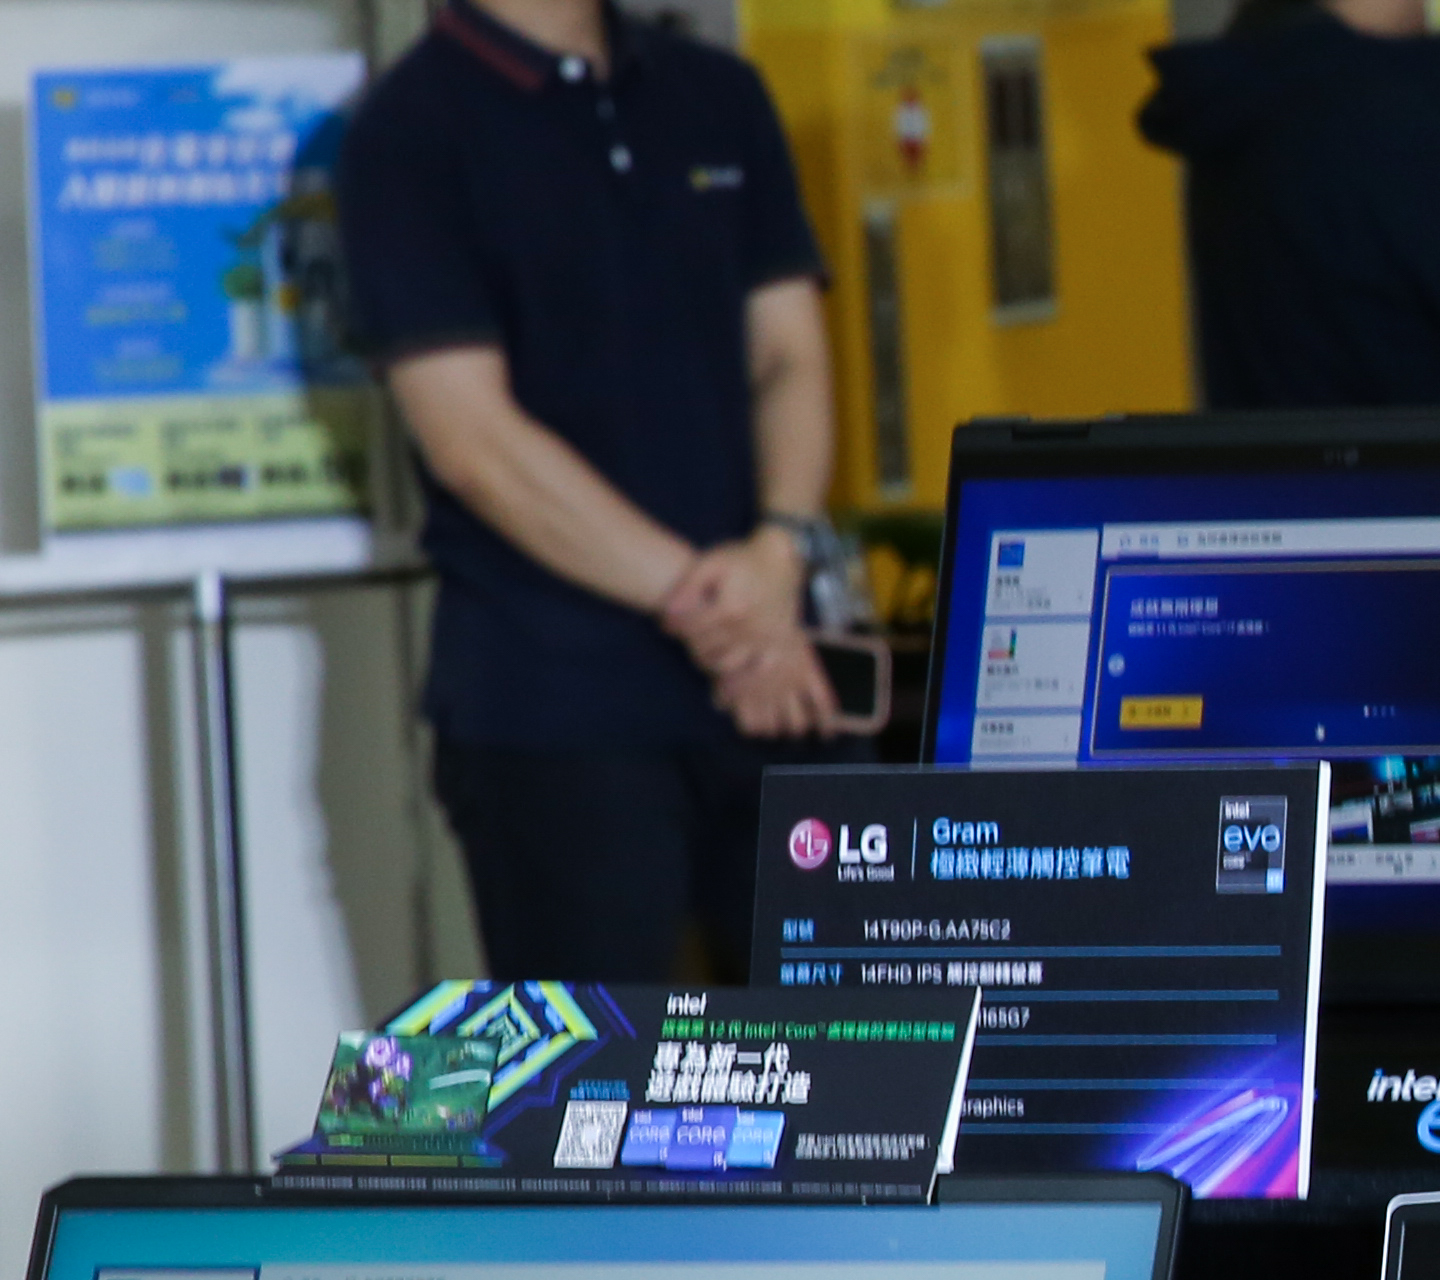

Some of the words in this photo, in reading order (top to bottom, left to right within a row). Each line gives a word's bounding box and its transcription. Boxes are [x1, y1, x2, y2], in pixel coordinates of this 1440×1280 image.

[838, 824, 889, 865] LG
[933, 818, 999, 845] Gram
[1224, 824, 1281, 853] evo
[917, 963, 942, 985] IPS
[667, 992, 707, 1016] intel
